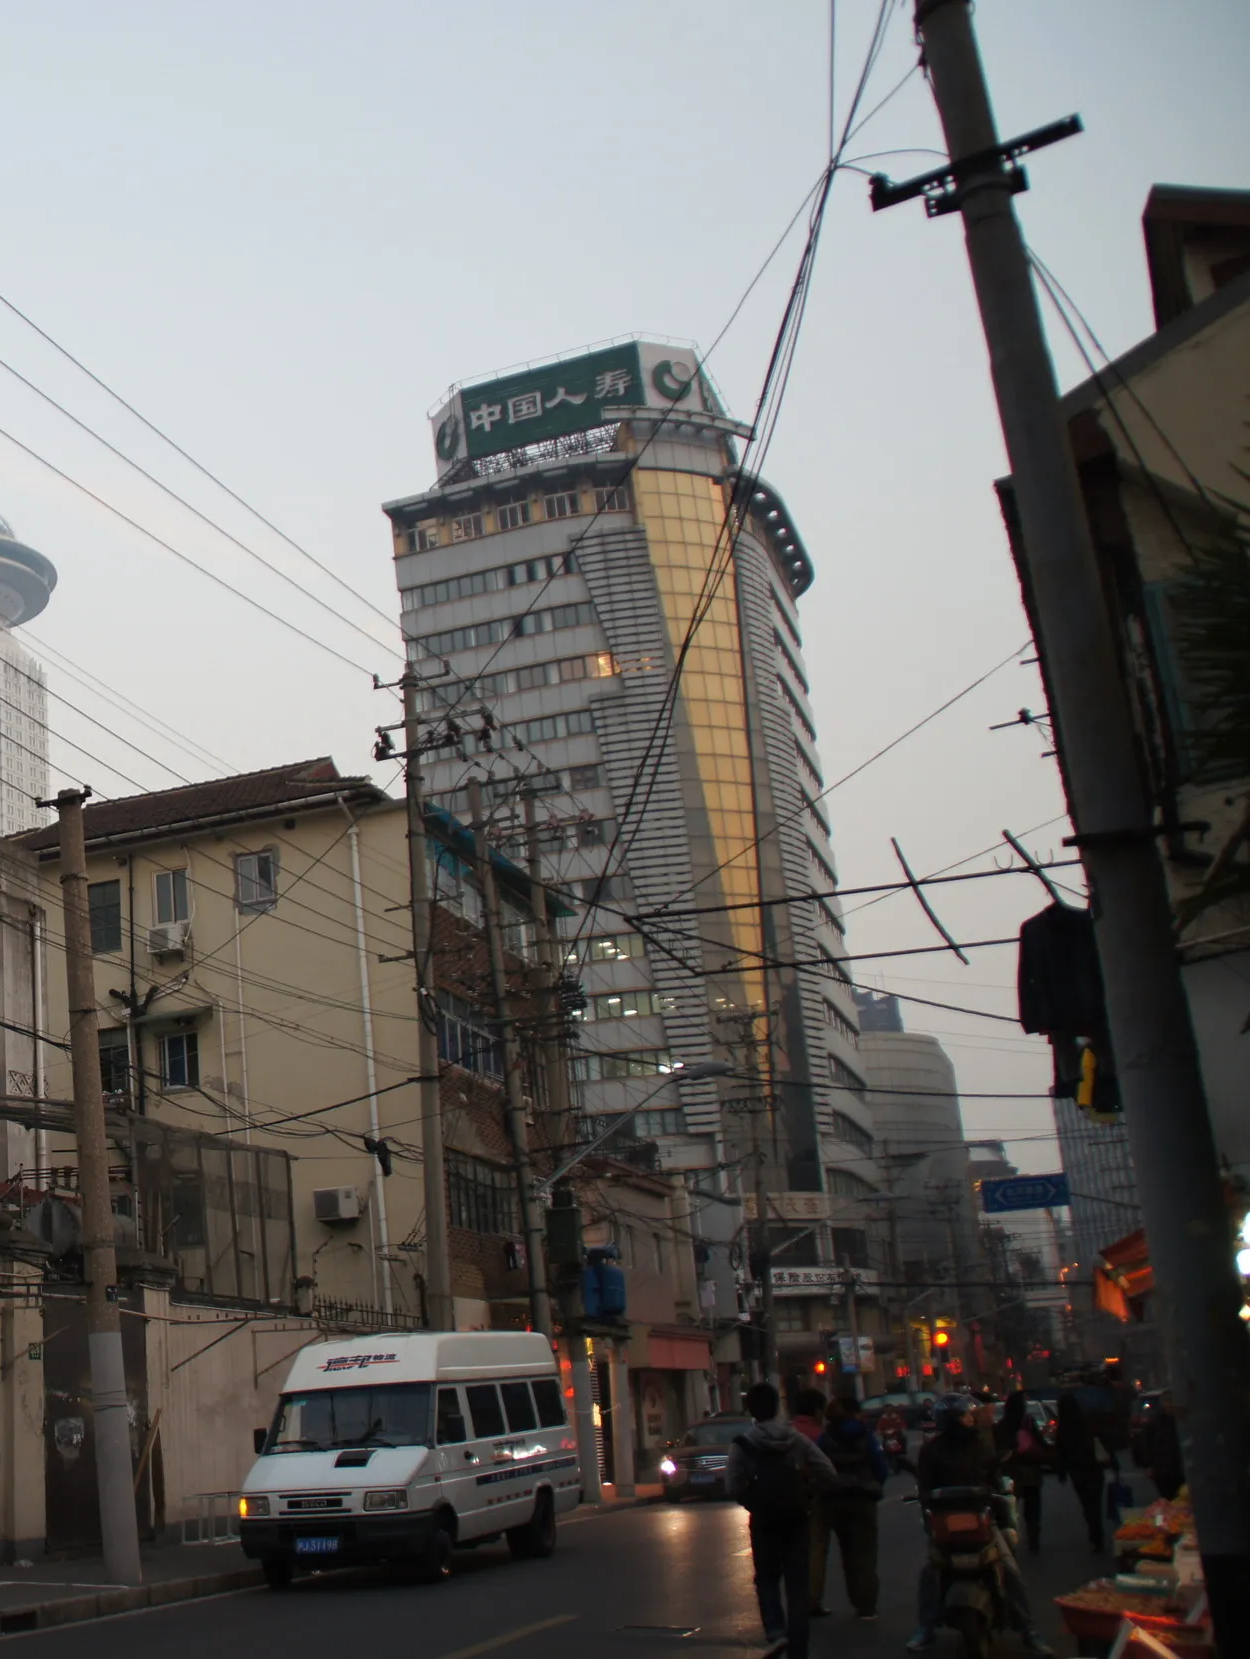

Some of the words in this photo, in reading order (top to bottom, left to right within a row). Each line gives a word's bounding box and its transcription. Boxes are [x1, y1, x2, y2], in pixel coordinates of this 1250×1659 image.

[470, 369, 632, 433] 中国人寿
[323, 1353, 397, 1372] 德邦物流
